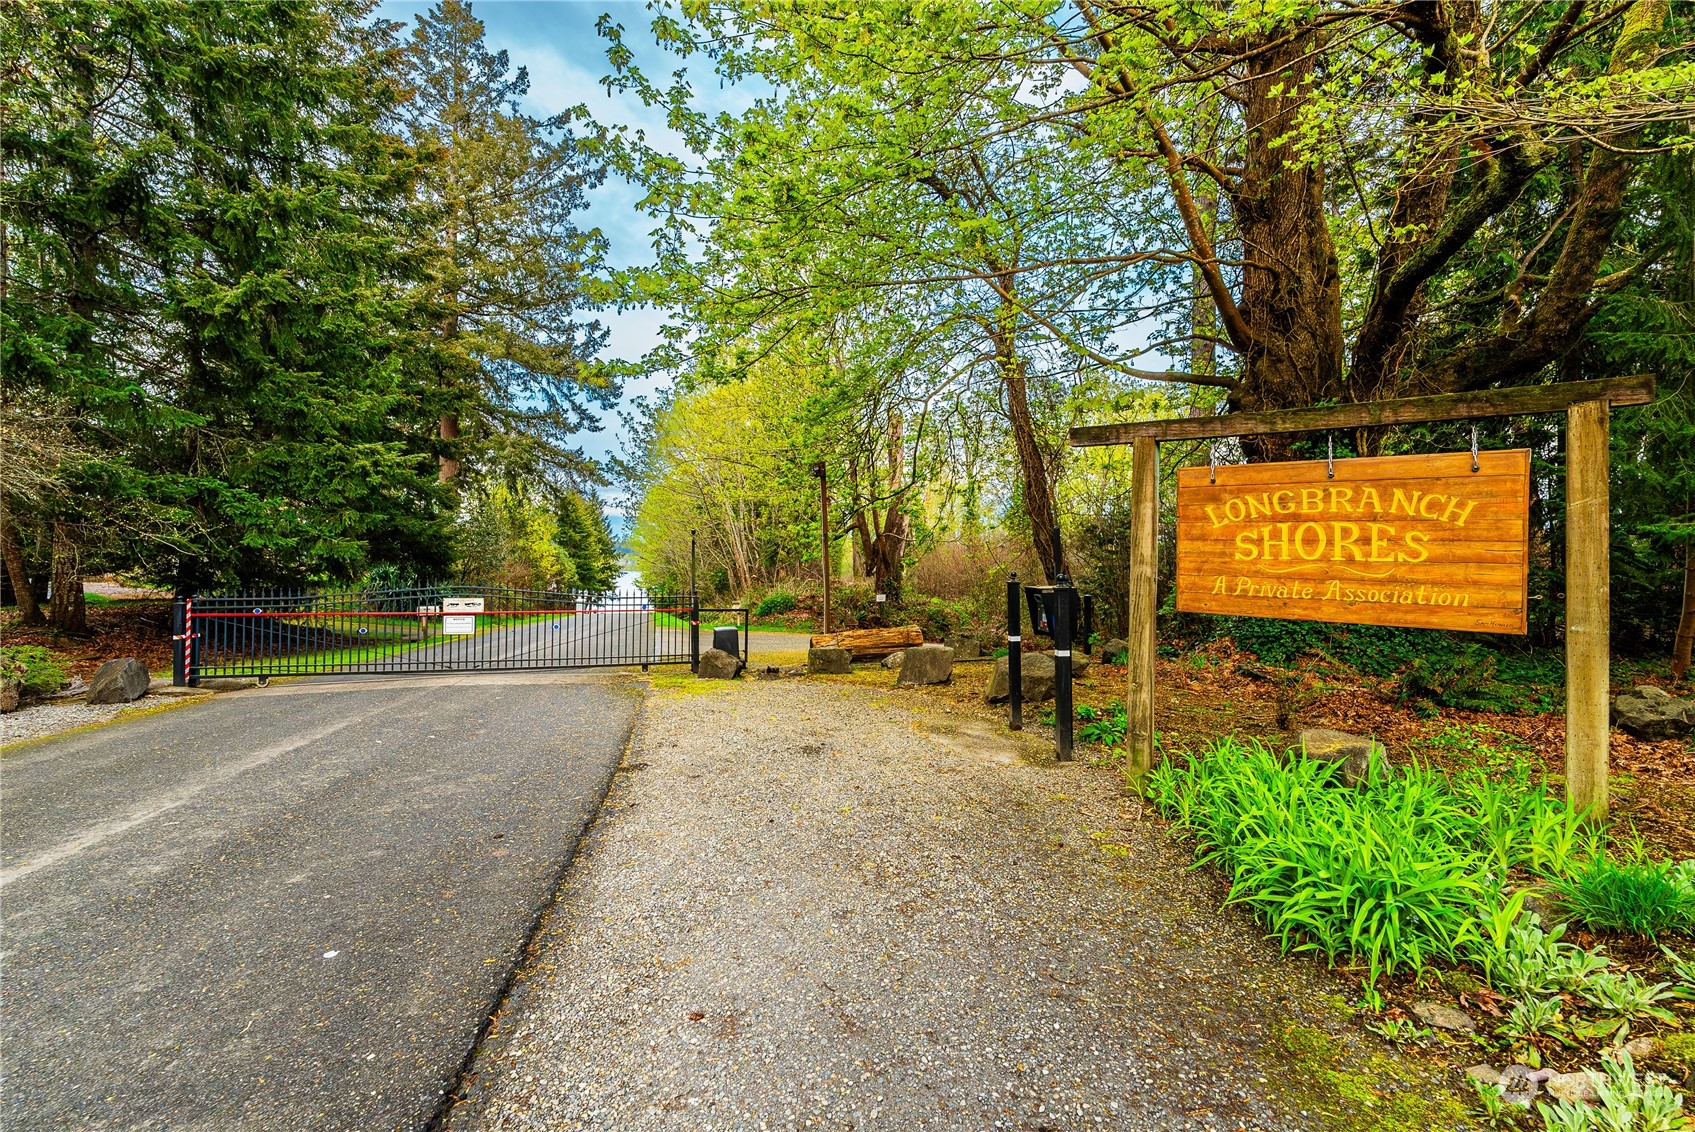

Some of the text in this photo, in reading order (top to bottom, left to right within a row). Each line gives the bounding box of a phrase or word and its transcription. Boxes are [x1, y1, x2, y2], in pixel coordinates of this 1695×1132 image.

[1204, 487, 1478, 529] LONGBRANCH
[1234, 521, 1432, 563] SHORES
[1211, 575, 1470, 607] A Private Association
